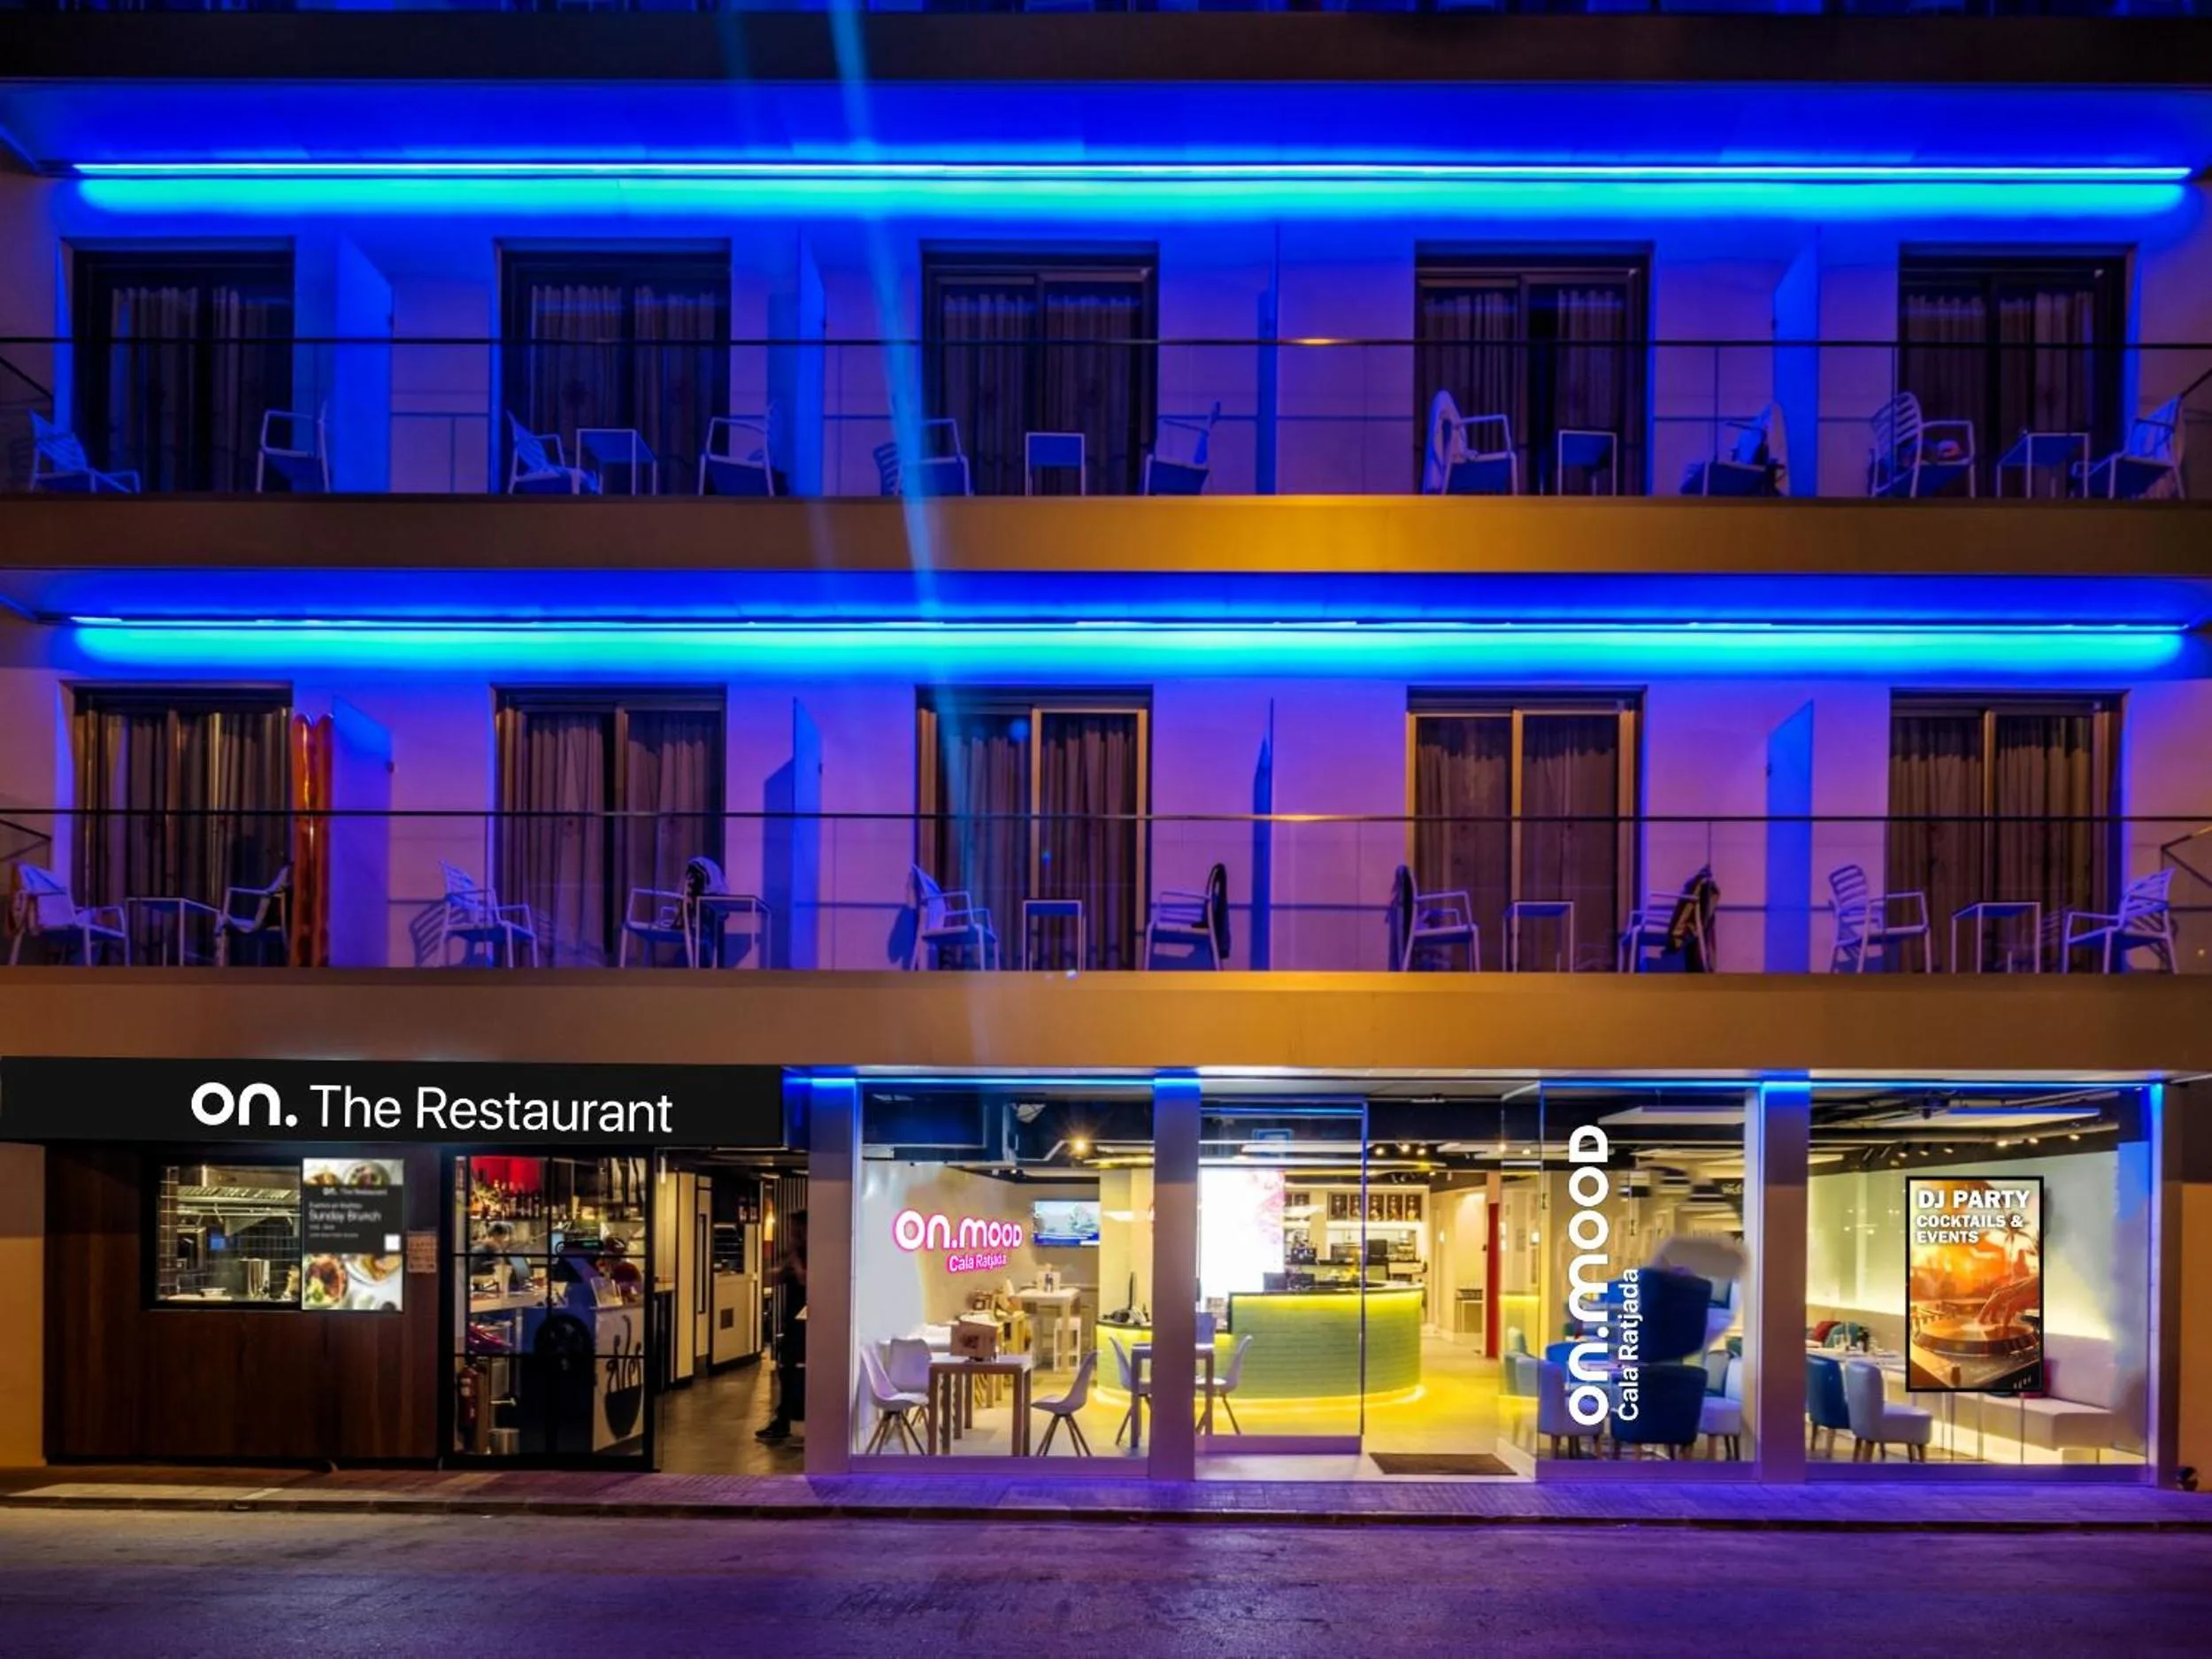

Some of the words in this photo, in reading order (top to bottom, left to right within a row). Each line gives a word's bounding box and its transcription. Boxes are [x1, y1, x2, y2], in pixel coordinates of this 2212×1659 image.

[191, 1081, 297, 1126] on.
[310, 1085, 401, 1127] The
[416, 1087, 672, 1133] Restaurant
[1917, 1189, 1946, 1209] DJ
[1953, 1189, 2030, 1209] PARTY
[1916, 1215, 2006, 1228] COCKTAILS
[2010, 1215, 2024, 1228] &
[1916, 1231, 1979, 1243] EVENTS
[949, 1255, 974, 1272] Cala
[1618, 1268, 1643, 1361] Ratjada
[1618, 1366, 1639, 1422] Cala
